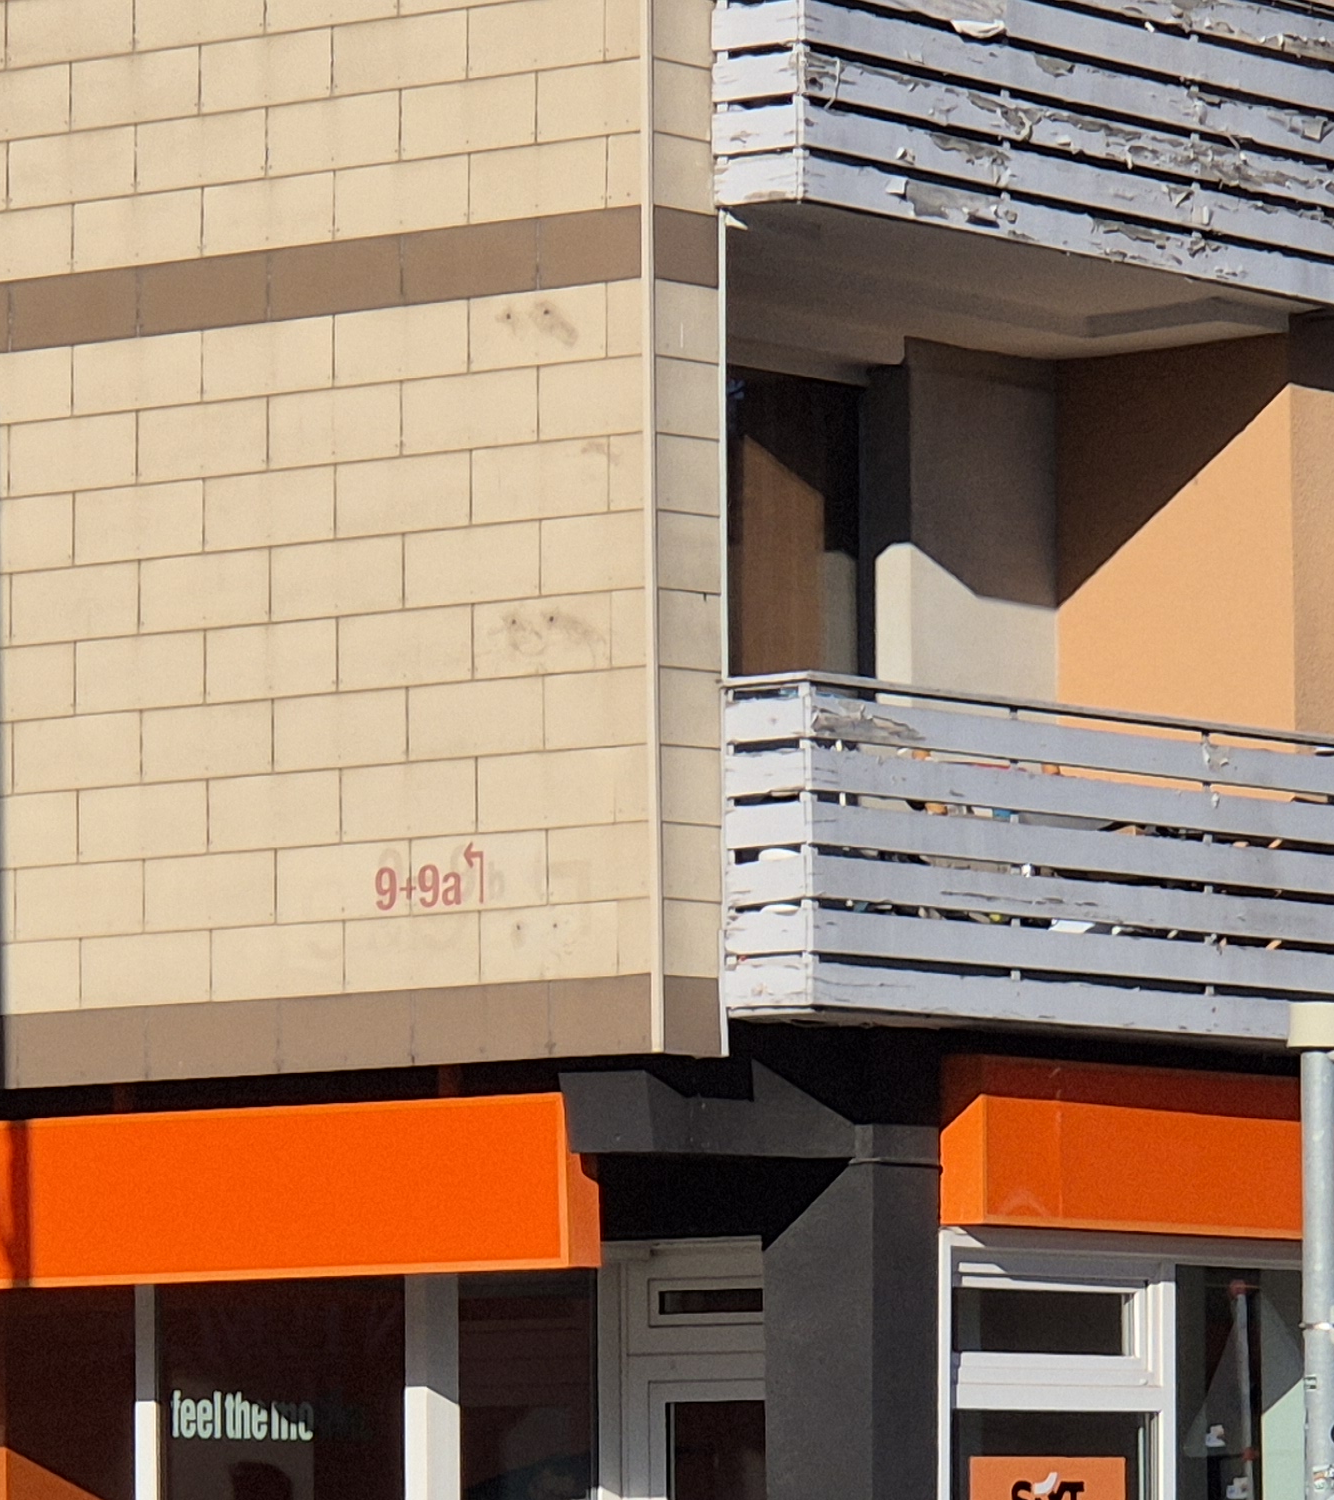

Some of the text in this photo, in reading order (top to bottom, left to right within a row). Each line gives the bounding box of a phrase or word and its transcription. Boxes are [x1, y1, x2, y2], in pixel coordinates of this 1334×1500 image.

[374, 863, 463, 911] 9+9a
[171, 1389, 223, 1440] feel
[224, 1390, 268, 1441] the
